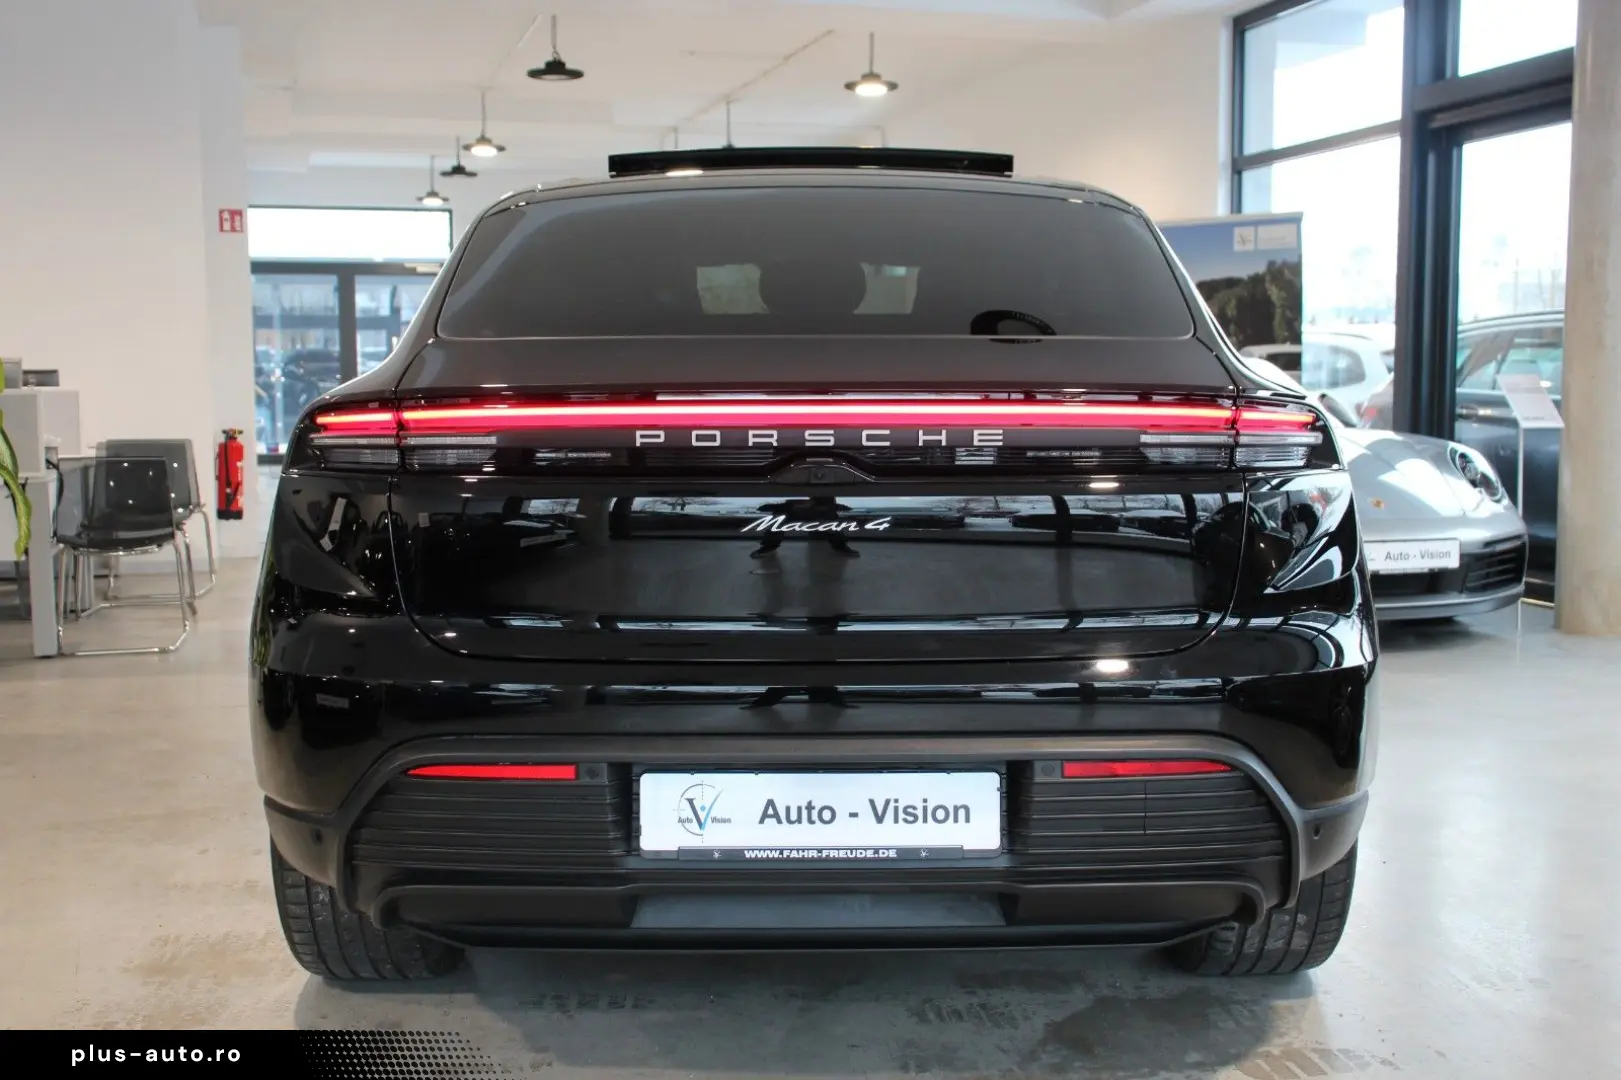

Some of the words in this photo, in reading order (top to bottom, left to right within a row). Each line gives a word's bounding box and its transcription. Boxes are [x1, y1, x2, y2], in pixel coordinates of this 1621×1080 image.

[635, 429, 1003, 446] PORSCHE
[740, 514, 860, 532] Macan
[864, 516, 892, 531] 4
[1384, 550, 1410, 562] Auto
[1419, 549, 1451, 560] Vision
[758, 798, 837, 825] Auto
[868, 797, 971, 824] Vision
[677, 816, 694, 824] Auto
[710, 816, 732, 824] Vision
[744, 849, 898, 858] WWW.FAHR-FREUDE.DE
